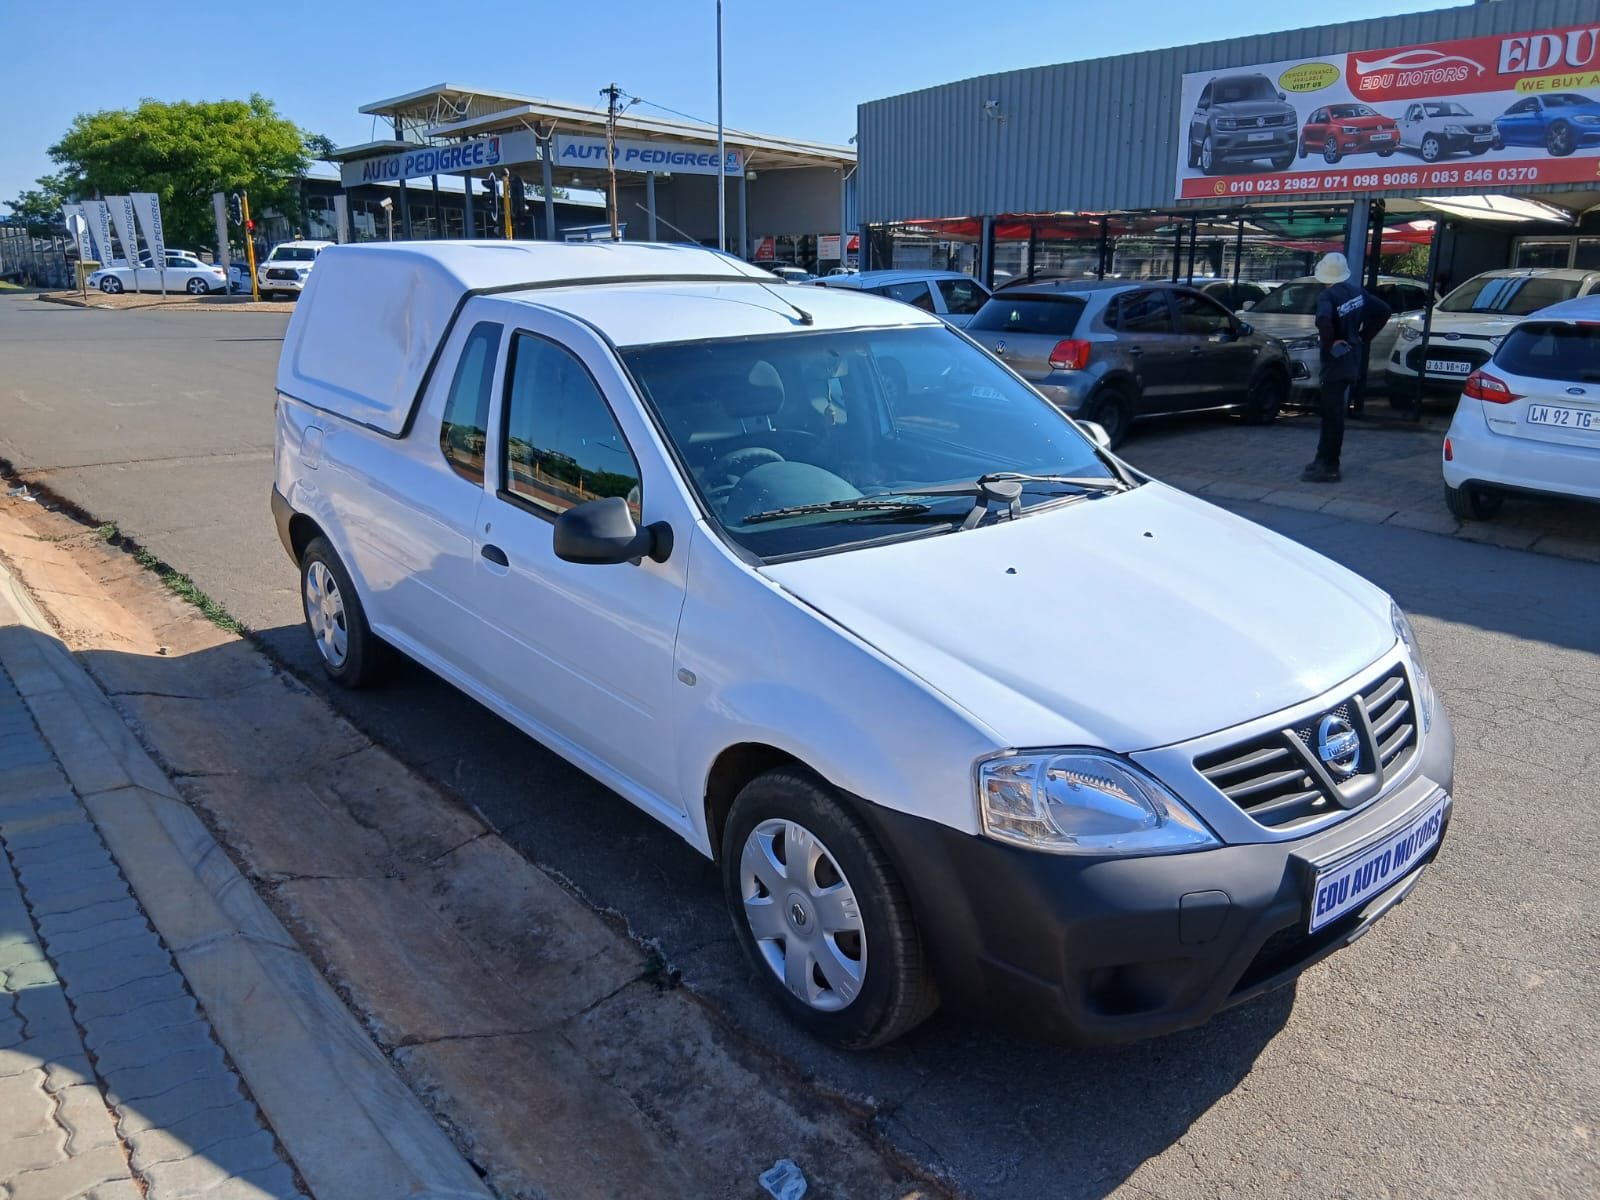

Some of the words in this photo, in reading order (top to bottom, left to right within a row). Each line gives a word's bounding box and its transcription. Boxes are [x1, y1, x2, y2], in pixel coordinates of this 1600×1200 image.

[1497, 28, 1600, 75] EDU
[1292, 82, 1310, 90] VISIT
[1360, 74, 1394, 90] EDU
[1396, 65, 1469, 87] MOTORS
[1521, 79, 1545, 91] WE
[1552, 76, 1584, 88] BUY
[362, 158, 399, 181] AUTO
[404, 142, 484, 176] PEDIGREE
[562, 144, 619, 160] AUTO
[625, 148, 719, 167] PEDIGREE
[1230, 181, 1253, 193] 010
[1257, 179, 1280, 191] 023
[1324, 175, 1348, 188] 071
[1353, 174, 1379, 187] 098
[1383, 172, 1418, 185] 9086
[1422, 171, 1428, 184] /
[1431, 171, 1459, 183] 083
[1463, 169, 1492, 182] 846
[1497, 167, 1538, 180] 0370
[98, 203, 110, 244] PEDIGREE
[123, 198, 136, 243] PEDIGREE
[150, 194, 162, 242] PEDIGREE
[104, 245, 112, 267] AUTO
[129, 244, 139, 267] AUTO
[156, 244, 165, 268] AUTO
[1434, 361, 1443, 370] 63
[1460, 363, 1470, 372] GP
[1531, 407, 1548, 423] LN
[1554, 409, 1569, 425] 92
[1576, 412, 1592, 427] TG
[1316, 874, 1350, 917] EDU
[1351, 849, 1391, 898] AUTO
[1393, 808, 1442, 871] MOTORS
